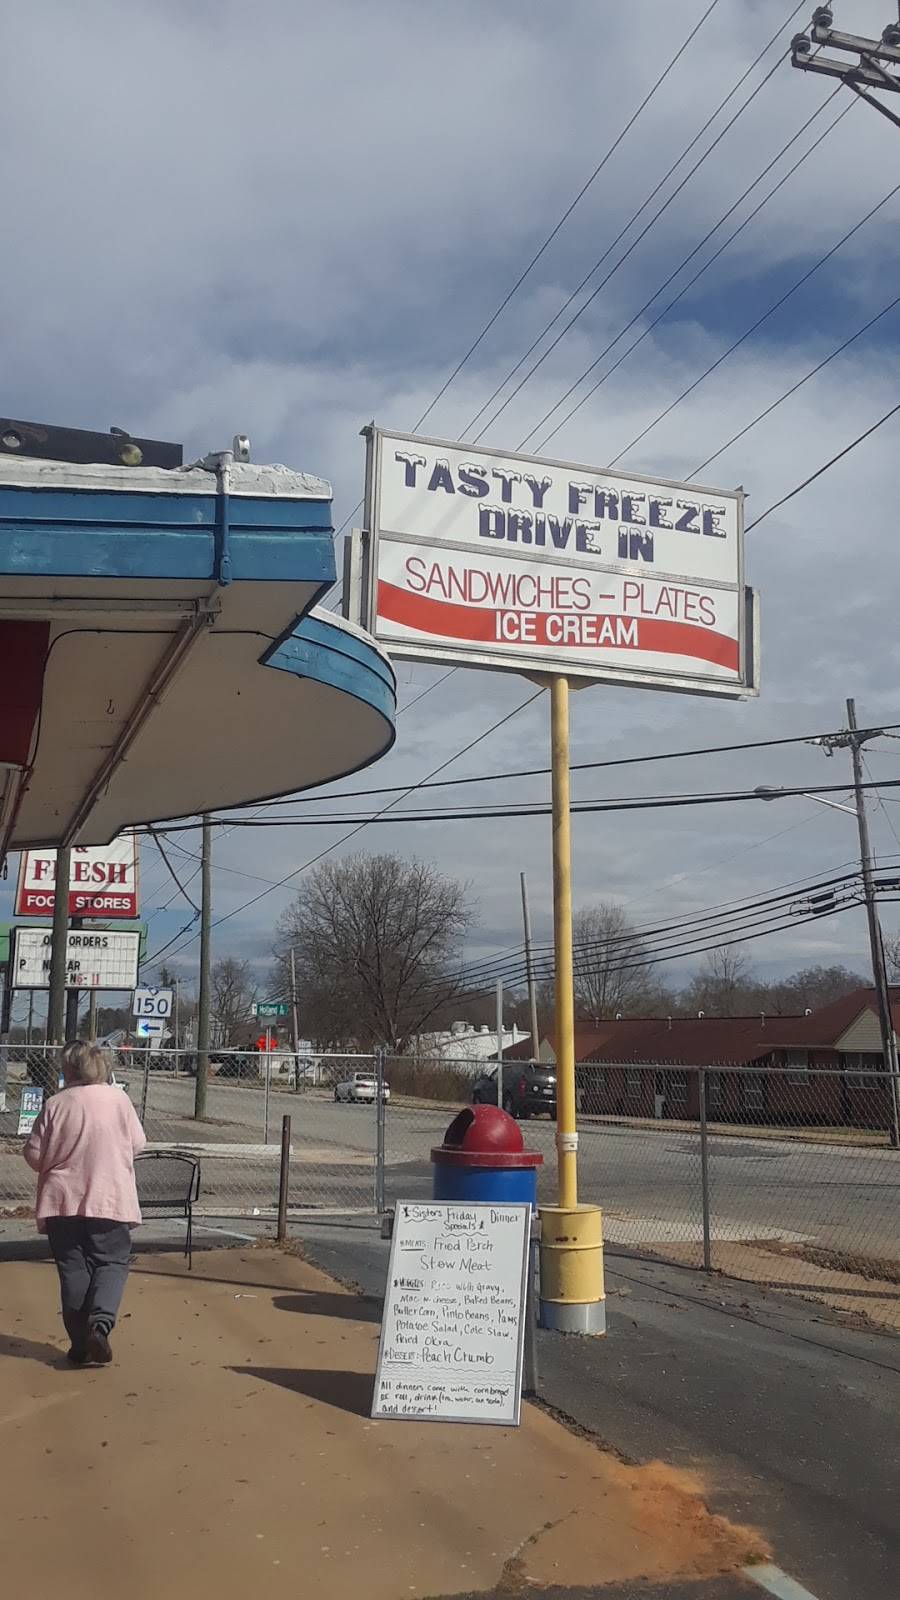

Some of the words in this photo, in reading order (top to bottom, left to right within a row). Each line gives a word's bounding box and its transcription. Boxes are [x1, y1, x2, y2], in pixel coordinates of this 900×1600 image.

[395, 451, 552, 508] TASTY
[568, 481, 727, 538] FREEZE
[478, 503, 602, 555] DRIVE
[618, 526, 654, 562] IN
[405, 557, 591, 610] SANDWICHES
[624, 581, 716, 626] PLATES
[495, 610, 536, 642] ICE
[546, 614, 638, 646] CREAM
[32, 859, 128, 884] FESH
[27, 895, 56, 908] FOO
[76, 896, 132, 910] STORES
[69, 936, 108, 948] ORDERS
[136, 998, 168, 1014] 150
[447, 1208, 476, 1222] Friday
[490, 1210, 518, 1223] Dinner
[434, 1238, 460, 1251] Fried
[467, 1238, 494, 1252] Perch
[459, 1257, 492, 1273] Meat
[464, 1295, 487, 1304] Baked
[424, 1336, 453, 1347] Okra
[422, 1347, 451, 1363] Peach
[454, 1348, 494, 1364] Crumb
[380, 1381, 391, 1390] All
[395, 1382, 424, 1391] dinners
[414, 1393, 438, 1402] drink
[382, 1404, 398, 1413] and
